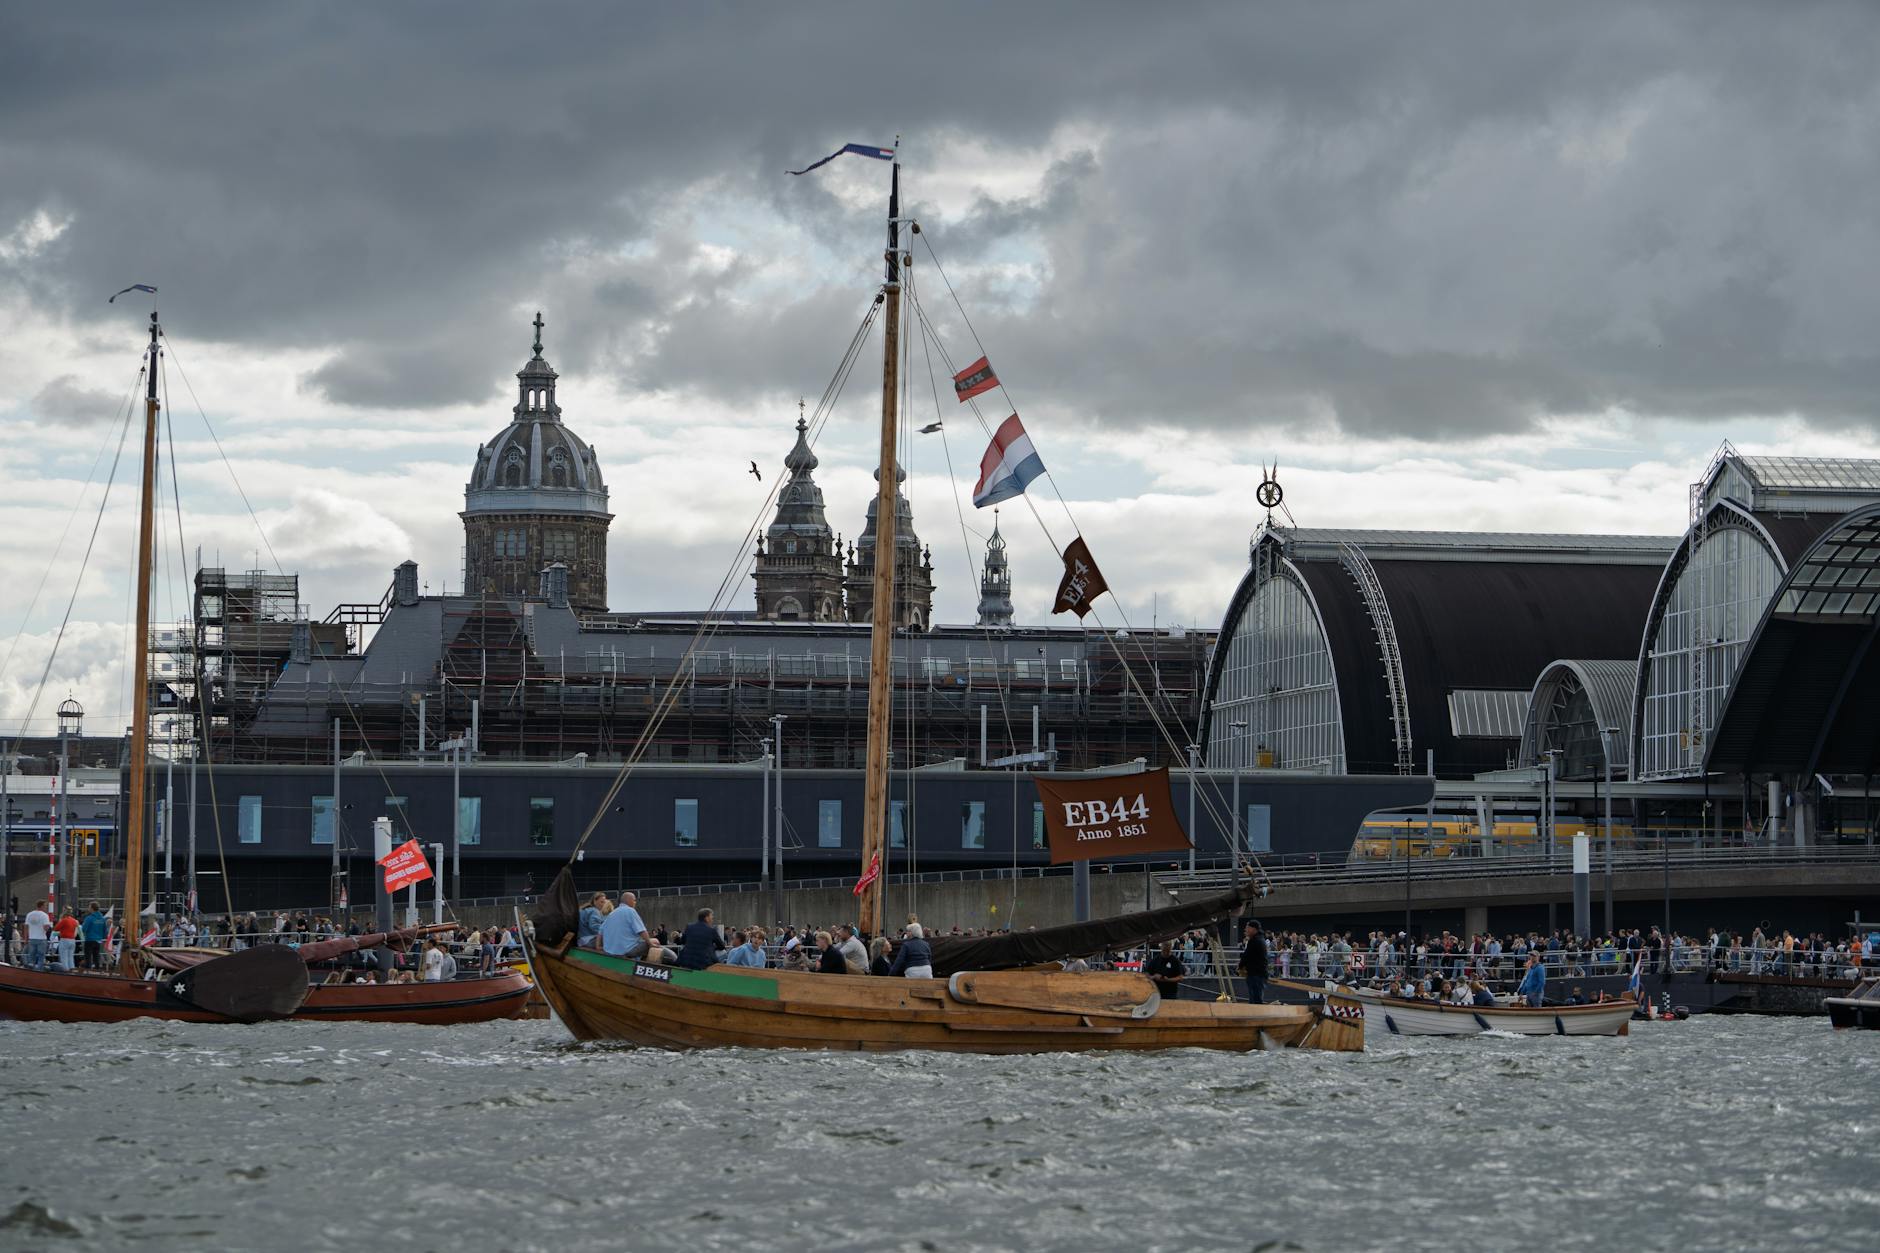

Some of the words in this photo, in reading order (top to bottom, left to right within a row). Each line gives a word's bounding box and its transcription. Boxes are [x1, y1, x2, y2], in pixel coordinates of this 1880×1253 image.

[1062, 793, 1150, 827] EB44
[1077, 829, 1112, 841] Anno
[1117, 823, 1147, 837] 1851
[635, 965, 669, 980] EB44
